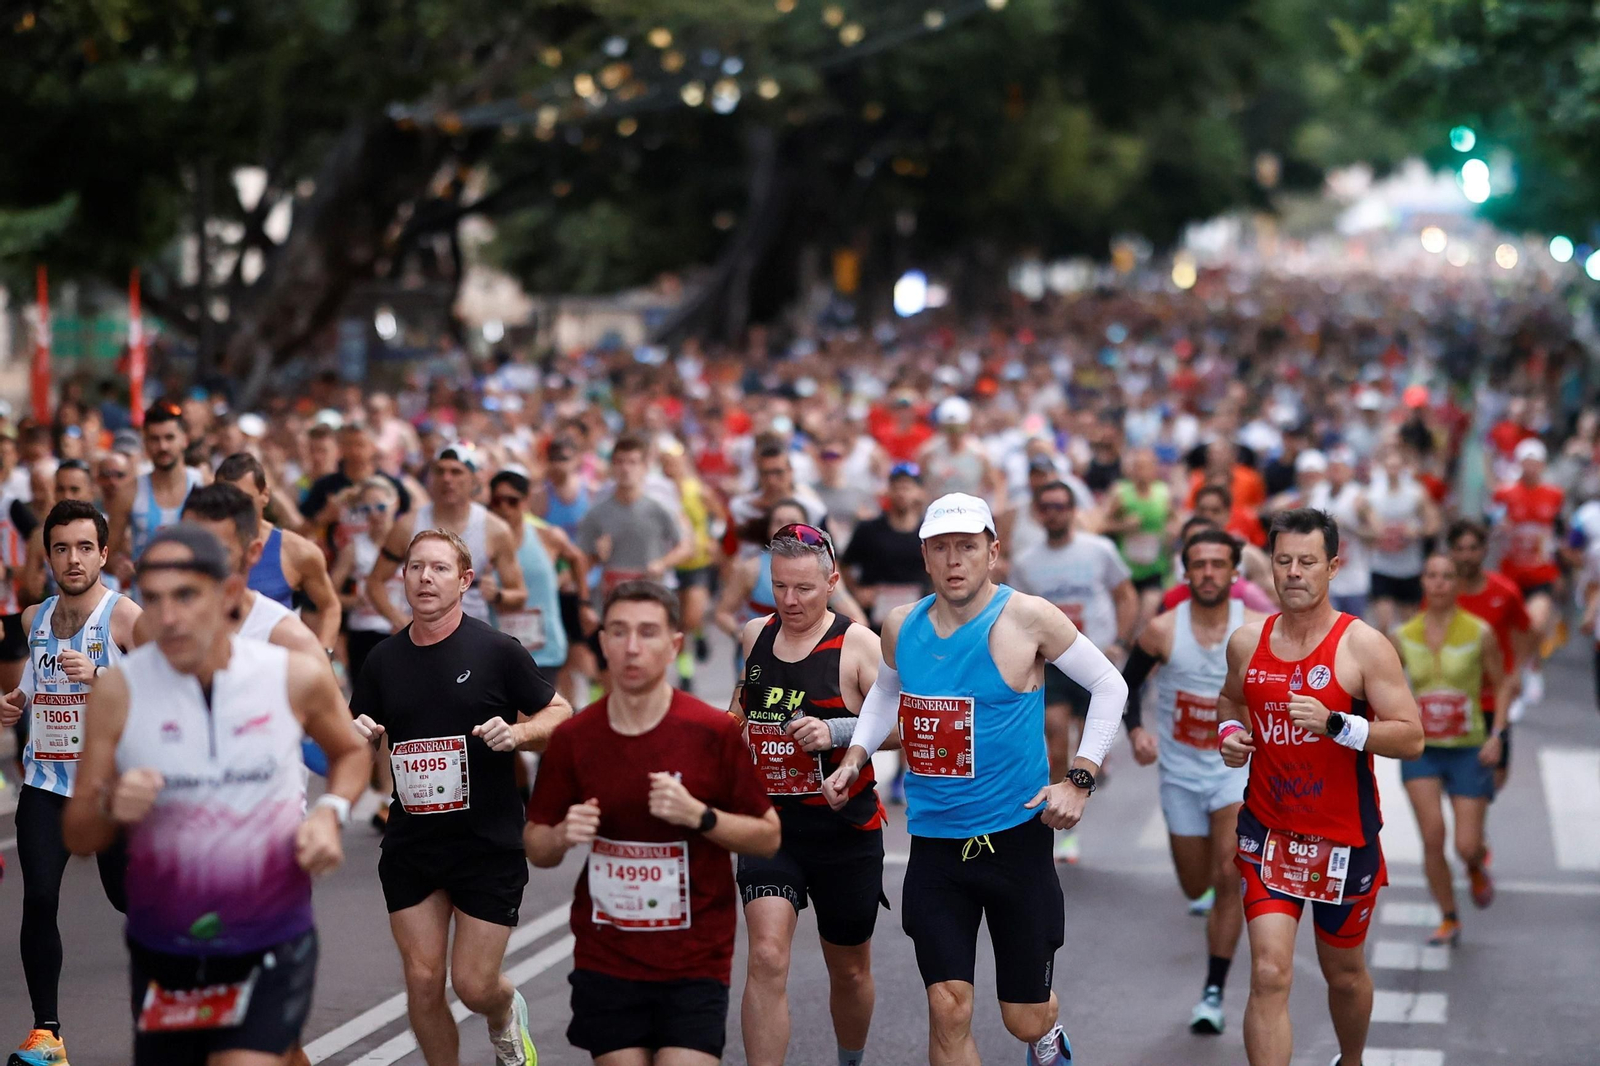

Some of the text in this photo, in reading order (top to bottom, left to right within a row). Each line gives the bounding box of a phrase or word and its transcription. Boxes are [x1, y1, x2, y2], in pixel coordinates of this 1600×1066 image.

[945, 505, 967, 515] edp
[38, 653, 64, 676] Ma
[45, 695, 86, 705] GENERALI
[911, 699, 959, 711] GENERALI
[1264, 702, 1290, 711] ATLET
[43, 710, 79, 723] 15061
[749, 711, 787, 722] RACING
[761, 725, 786, 736] GENE
[913, 716, 940, 733] 937
[1254, 711, 1320, 746] Vélez
[407, 740, 453, 753] GENERALI
[761, 741, 795, 756] 2066
[403, 757, 447, 773] 14995
[1288, 841, 1318, 858] 803
[606, 862, 662, 882] 14990
